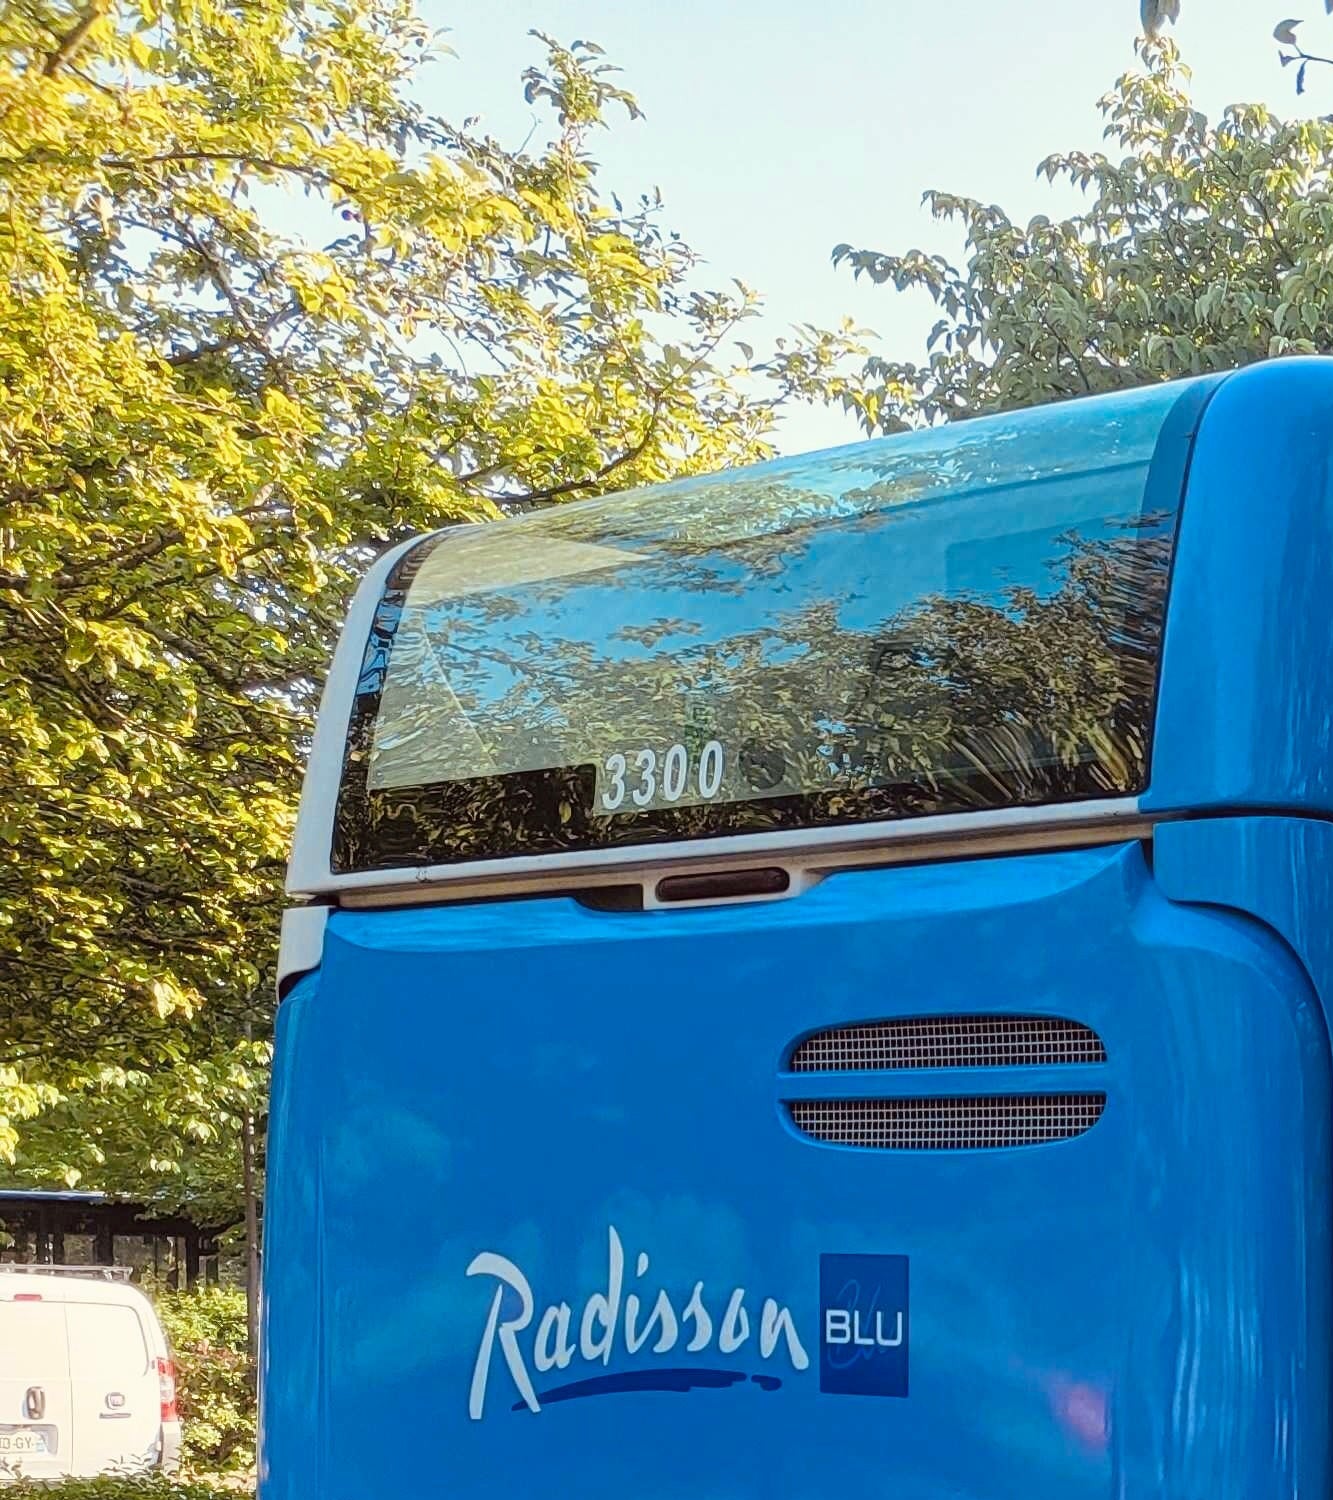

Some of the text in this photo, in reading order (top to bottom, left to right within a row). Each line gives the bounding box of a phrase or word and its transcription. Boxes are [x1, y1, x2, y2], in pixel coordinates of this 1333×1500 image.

[602, 741, 723, 809] 3300
[466, 1225, 903, 1420] Radisson BLU
